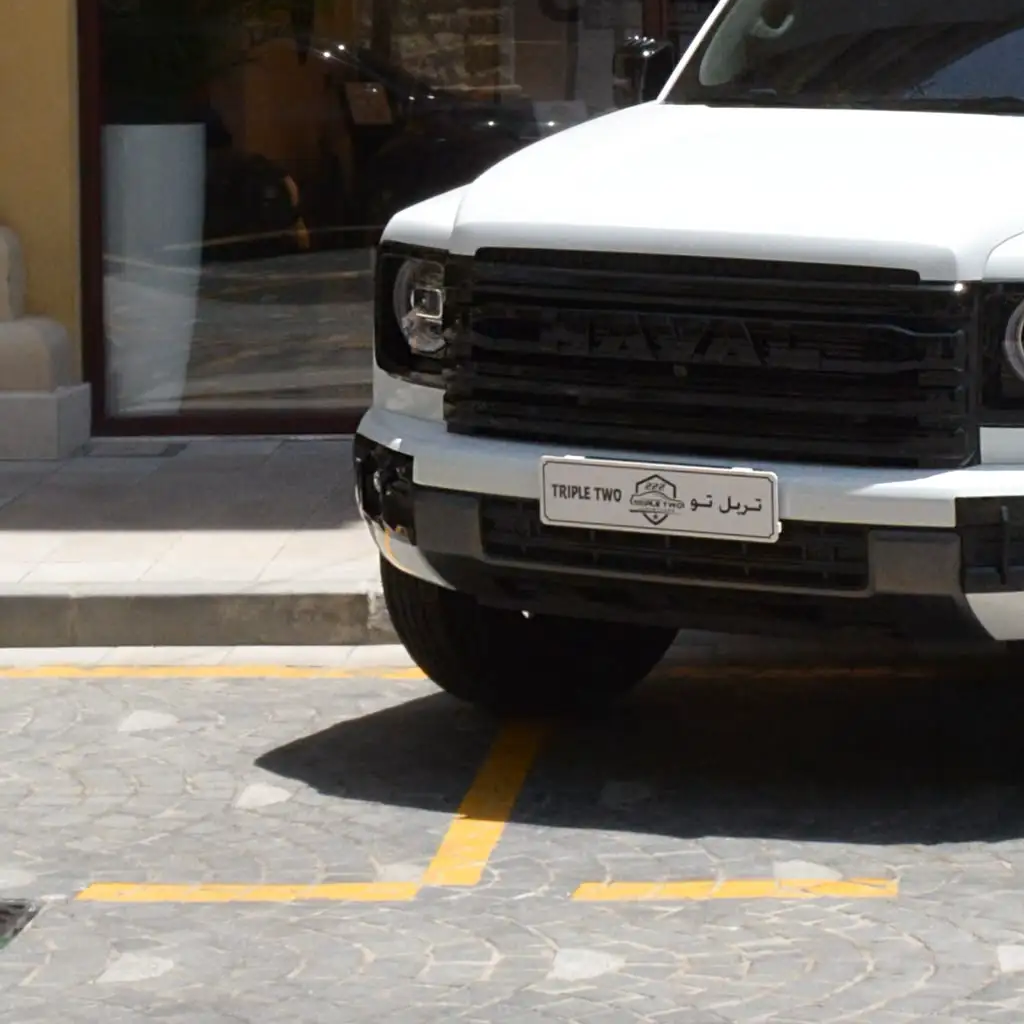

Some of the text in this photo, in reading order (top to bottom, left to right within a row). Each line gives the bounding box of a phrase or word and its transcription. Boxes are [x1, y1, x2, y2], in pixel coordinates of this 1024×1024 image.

[552, 483, 622, 503] TRIPLE TWO
[690, 494, 713, 511] تو
